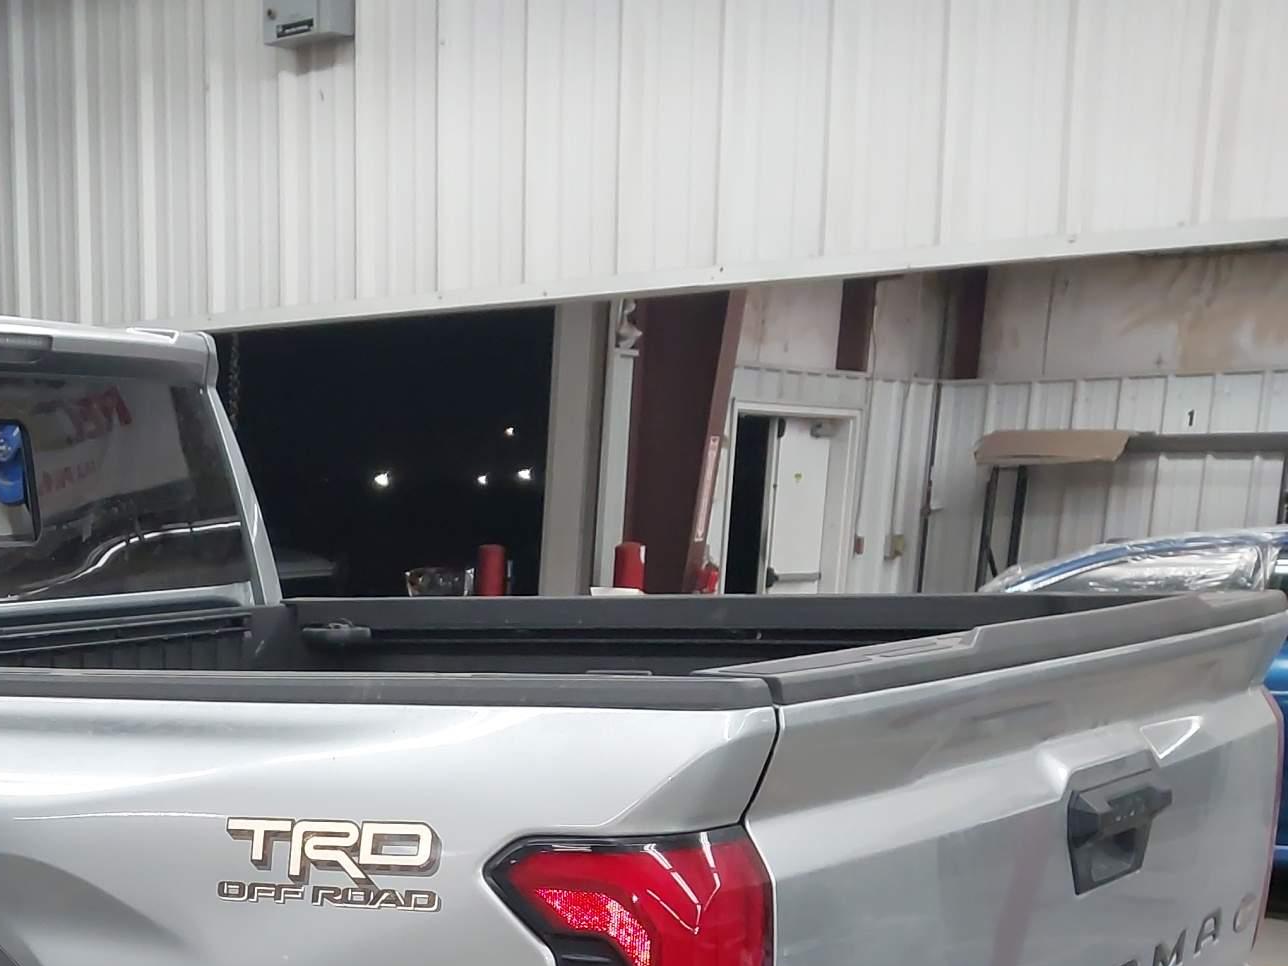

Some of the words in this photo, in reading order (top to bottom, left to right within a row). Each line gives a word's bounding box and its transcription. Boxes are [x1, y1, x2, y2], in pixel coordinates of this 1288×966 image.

[1186, 409, 1195, 427] 1
[225, 816, 442, 885] TRD
[217, 880, 306, 904] OFF
[312, 884, 441, 912] ROAD
